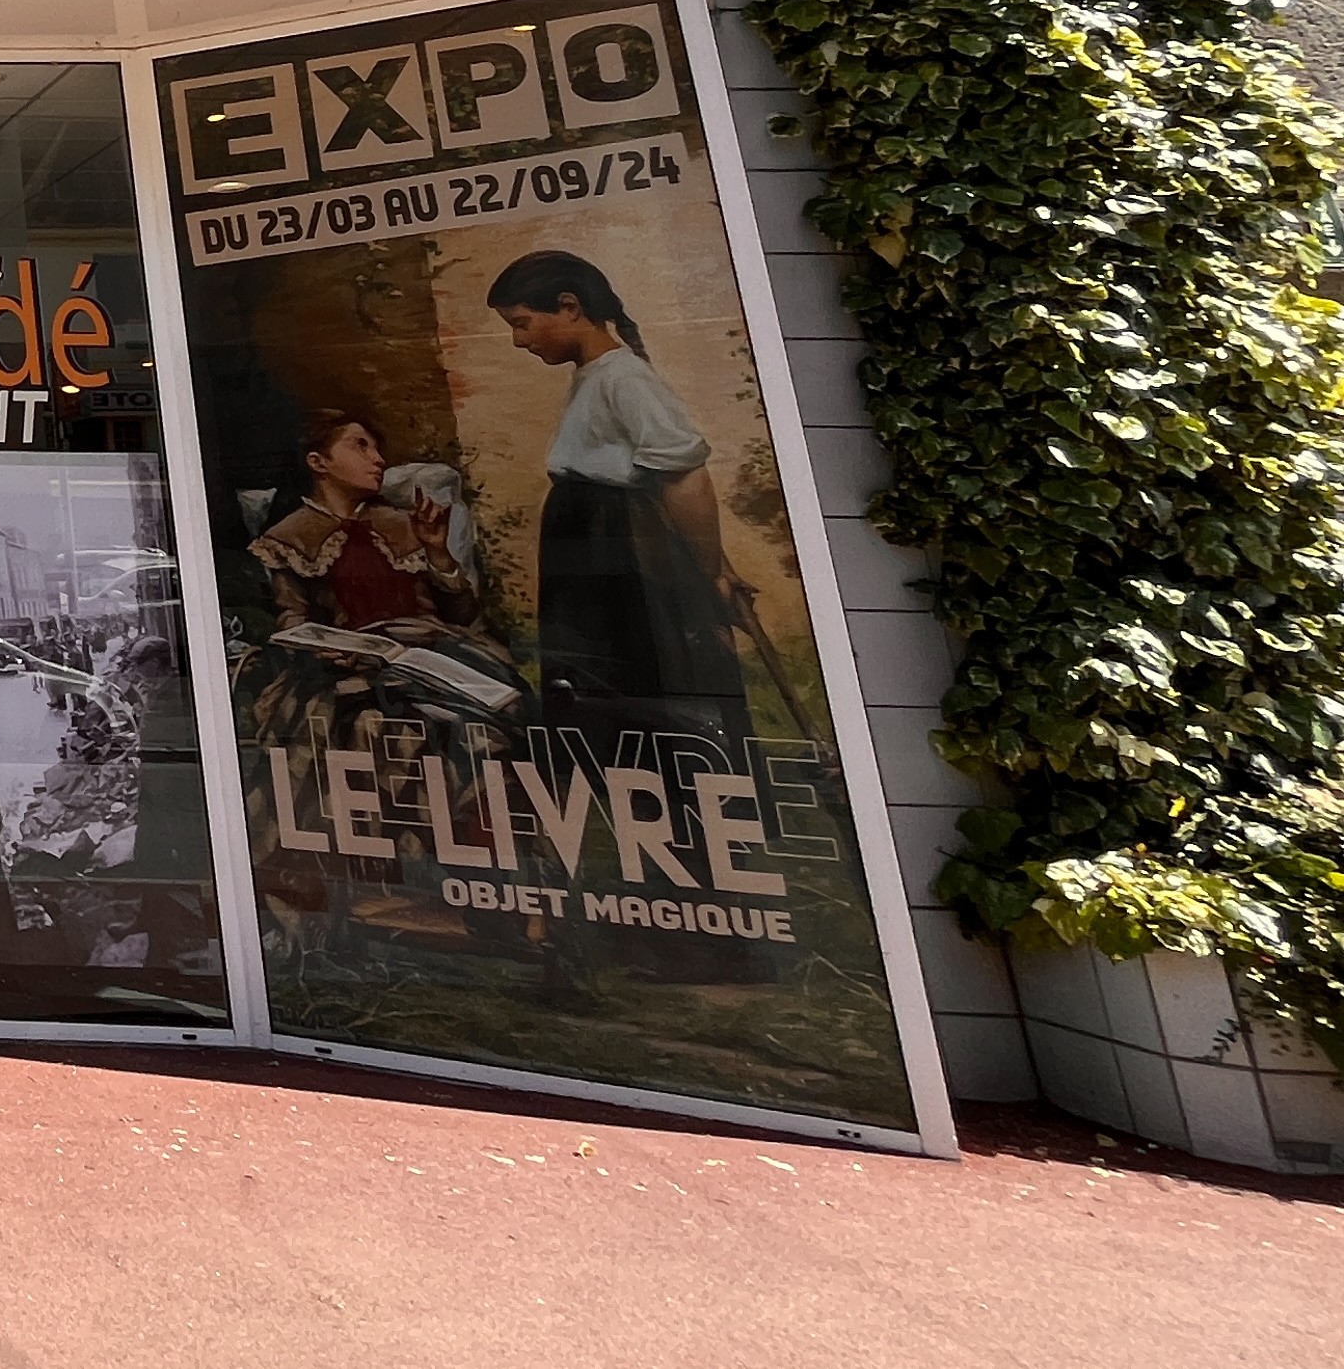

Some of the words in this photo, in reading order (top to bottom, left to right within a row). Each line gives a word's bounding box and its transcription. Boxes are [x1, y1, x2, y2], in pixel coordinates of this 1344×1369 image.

[183, 22, 661, 181] EXPO
[199, 215, 249, 256] DU
[257, 194, 377, 246] 23/03
[386, 182, 440, 227] AU
[448, 146, 681, 218] 22/09/24
[269, 746, 397, 860] LE
[422, 755, 788, 898] LIVRE
[441, 877, 569, 919] OBJET
[582, 891, 797, 944] MAGIQUE
